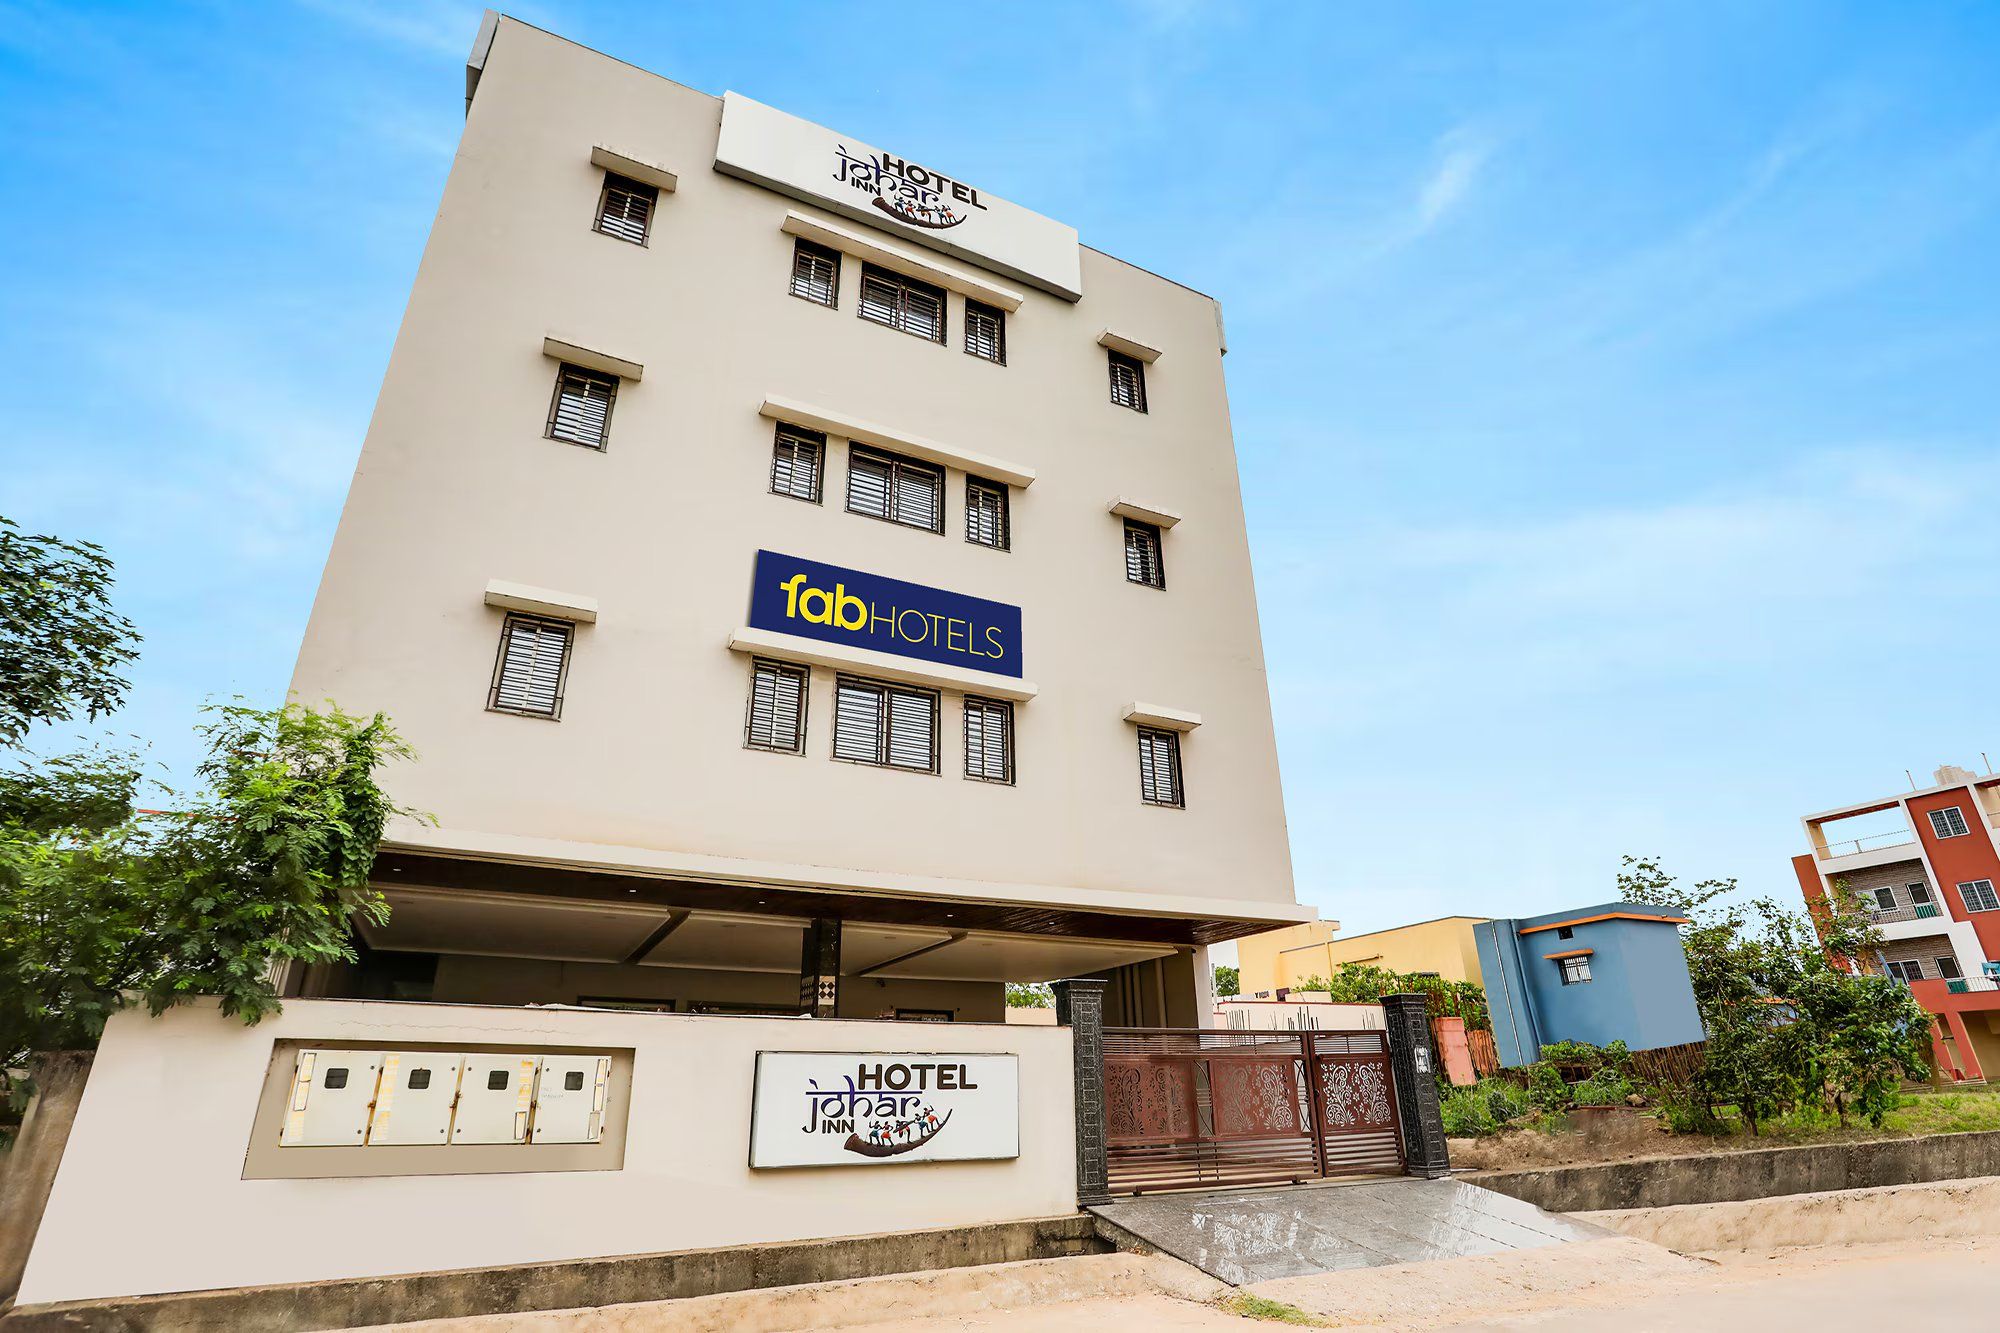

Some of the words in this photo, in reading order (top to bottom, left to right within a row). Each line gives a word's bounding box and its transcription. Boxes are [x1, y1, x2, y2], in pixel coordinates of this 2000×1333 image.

[851, 177, 881, 196] INN
[883, 153, 988, 211] HOTEL
[858, 1063, 978, 1091] HOTEL
[821, 1119, 855, 1134] INN
